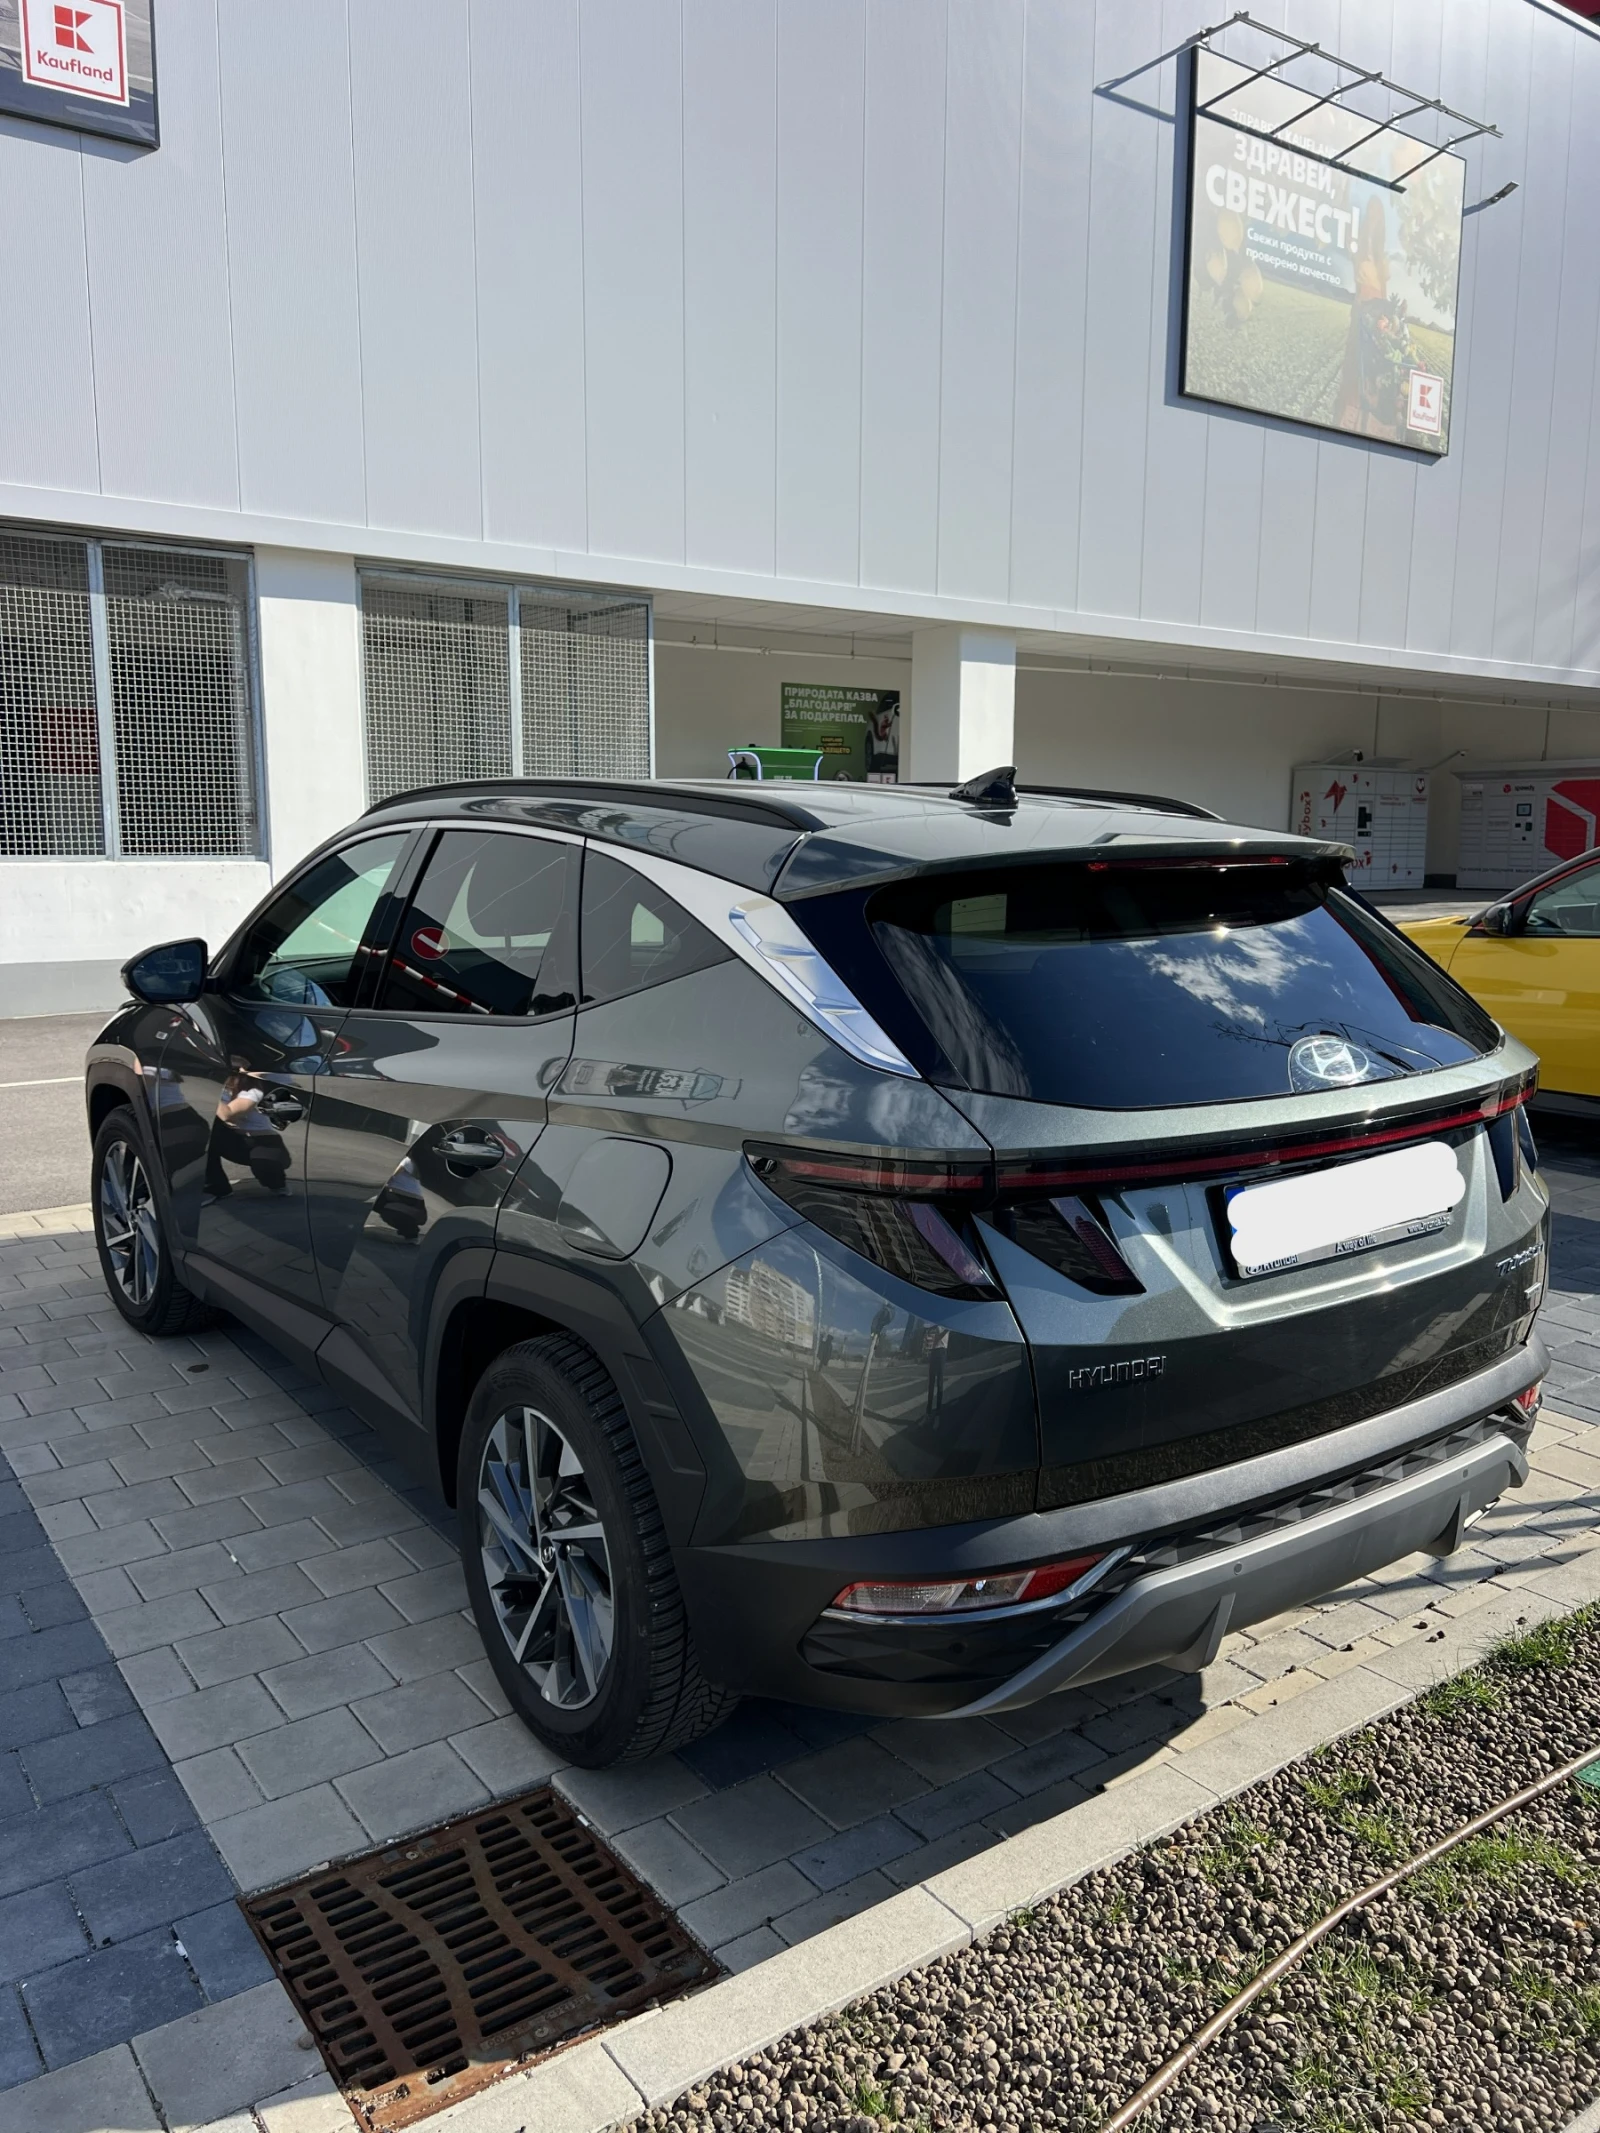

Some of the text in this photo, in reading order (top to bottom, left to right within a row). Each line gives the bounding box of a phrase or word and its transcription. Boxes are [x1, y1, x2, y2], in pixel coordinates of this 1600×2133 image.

[37, 50, 113, 82] Kaufland
[1205, 164, 1360, 253] СВЕЖЕСТ!
[1247, 227, 1332, 266] Свежи продукти с
[1246, 247, 1341, 285] проверено качество
[784, 687, 878, 702] ПРИРОДАТА КАЗВА
[784, 710, 867, 723] ЗА ПОДКРЕПАТА.
[1069, 1355, 1167, 1389] HYUNDAI
